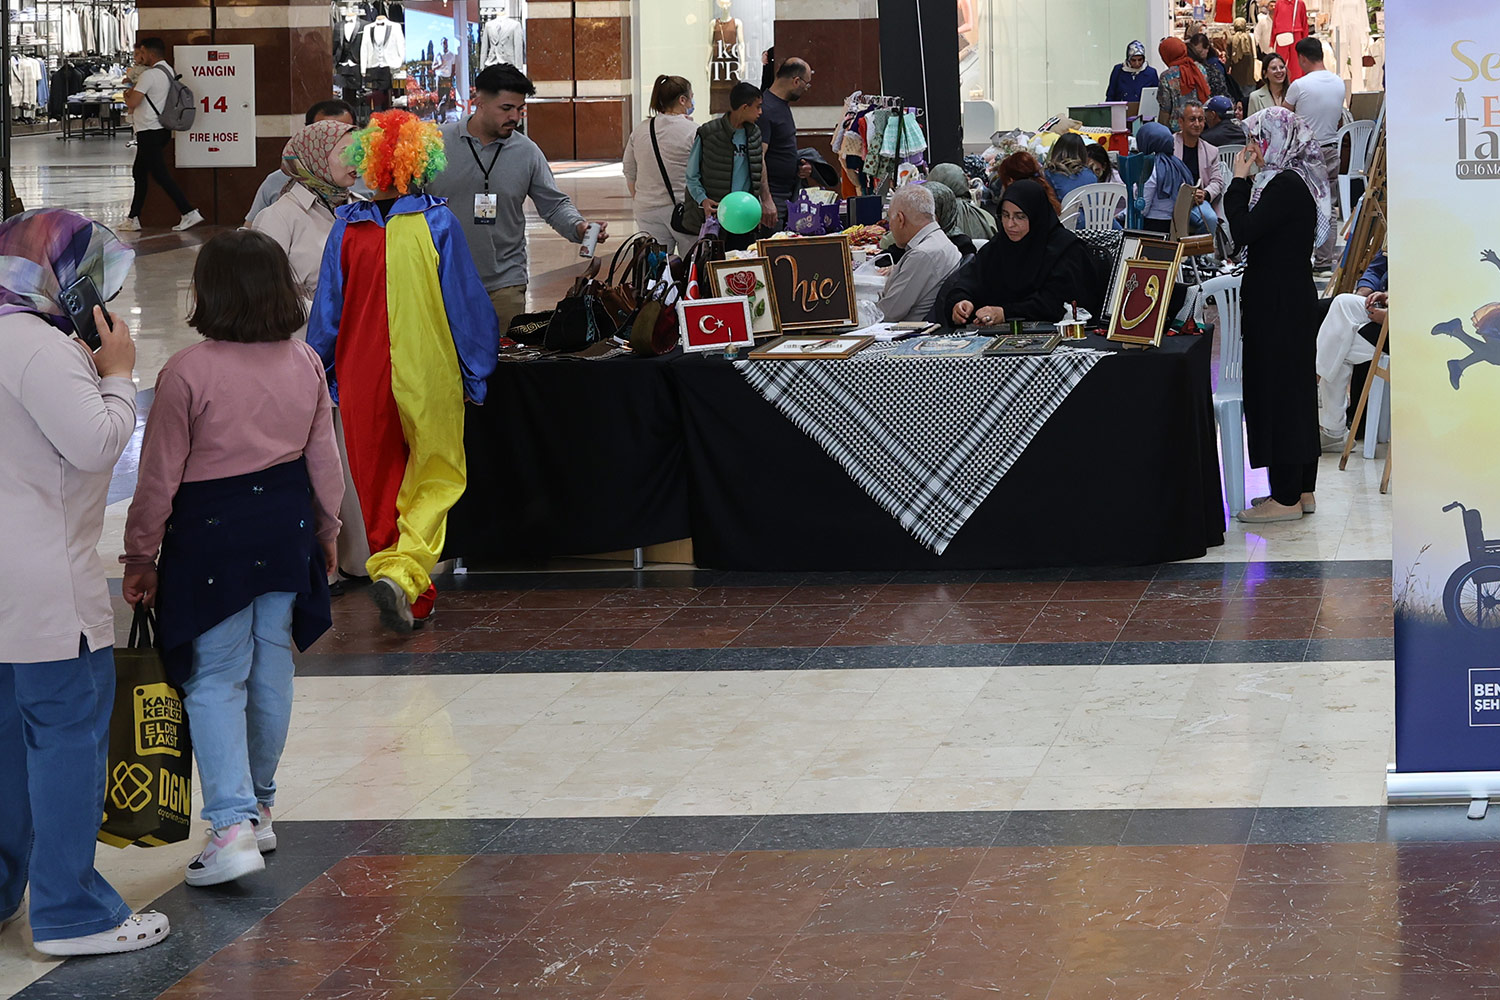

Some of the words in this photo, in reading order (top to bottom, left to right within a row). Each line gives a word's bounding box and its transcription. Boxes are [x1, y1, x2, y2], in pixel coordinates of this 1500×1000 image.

[192, 66, 235, 77] YANGIN
[200, 96, 228, 113] 14
[189, 132, 210, 142] FIRE
[213, 132, 239, 142] HOSE
[158, 767, 191, 816] DGN
